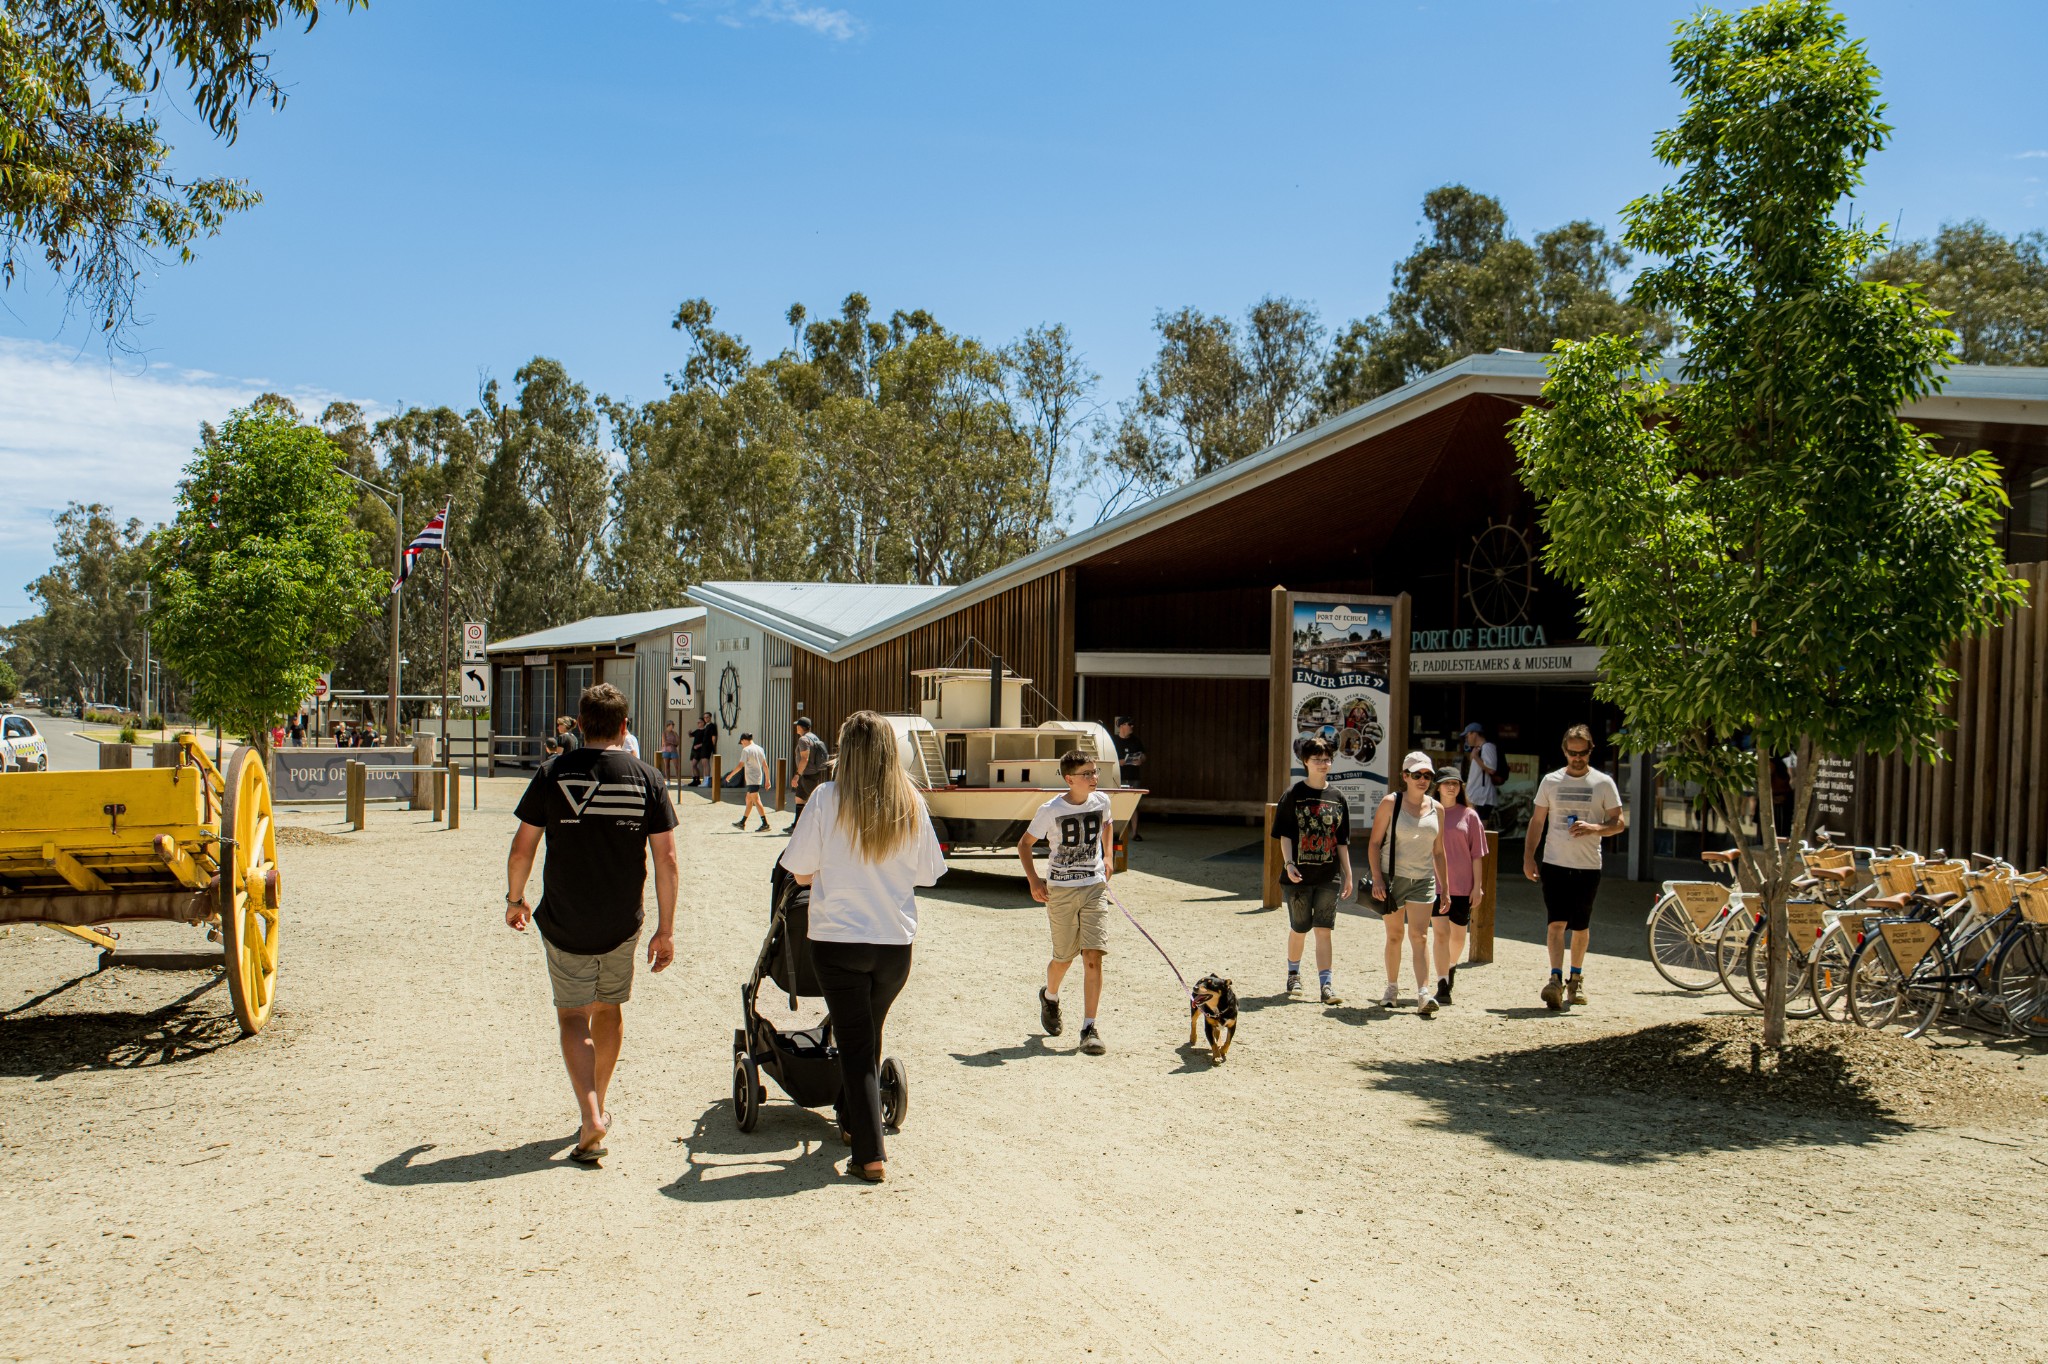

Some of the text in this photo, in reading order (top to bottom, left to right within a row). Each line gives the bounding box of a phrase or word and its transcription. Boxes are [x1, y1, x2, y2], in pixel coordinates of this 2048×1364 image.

[1412, 624, 1547, 650] PORT OF ECHUCA
[1423, 657, 1510, 672] PADDLESTEAMERS
[1512, 657, 1521, 670] &
[1525, 656, 1573, 670] MUSEUM
[1296, 671, 1371, 687] ENTER HERE
[1344, 693, 1359, 701] STEAM
[290, 768, 326, 781] PORT
[329, 768, 346, 781] OF
[1848, 770, 1855, 779] &
[1830, 781, 1854, 793] Walking
[1828, 792, 1849, 802] Tickets
[1818, 803, 1844, 815] Gift Shop
